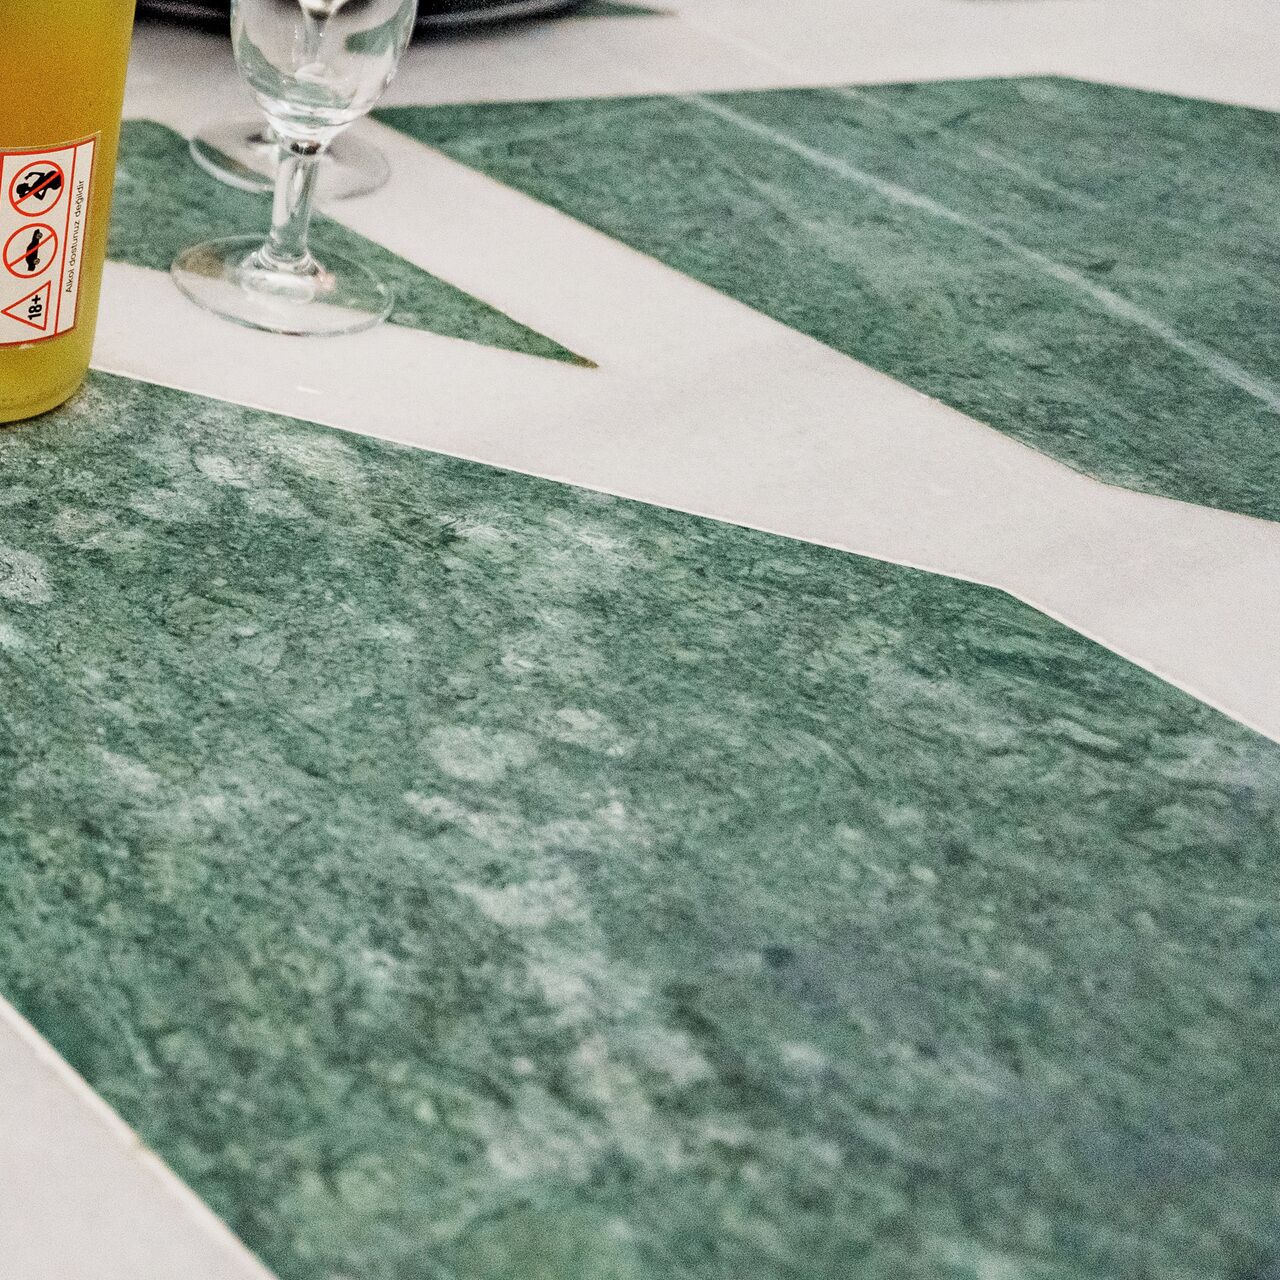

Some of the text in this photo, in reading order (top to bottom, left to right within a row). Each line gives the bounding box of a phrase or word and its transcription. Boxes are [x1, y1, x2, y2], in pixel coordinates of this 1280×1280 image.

[65, 180, 85, 293] Alkol dostunuz değildir
[27, 294, 43, 321] 18+
